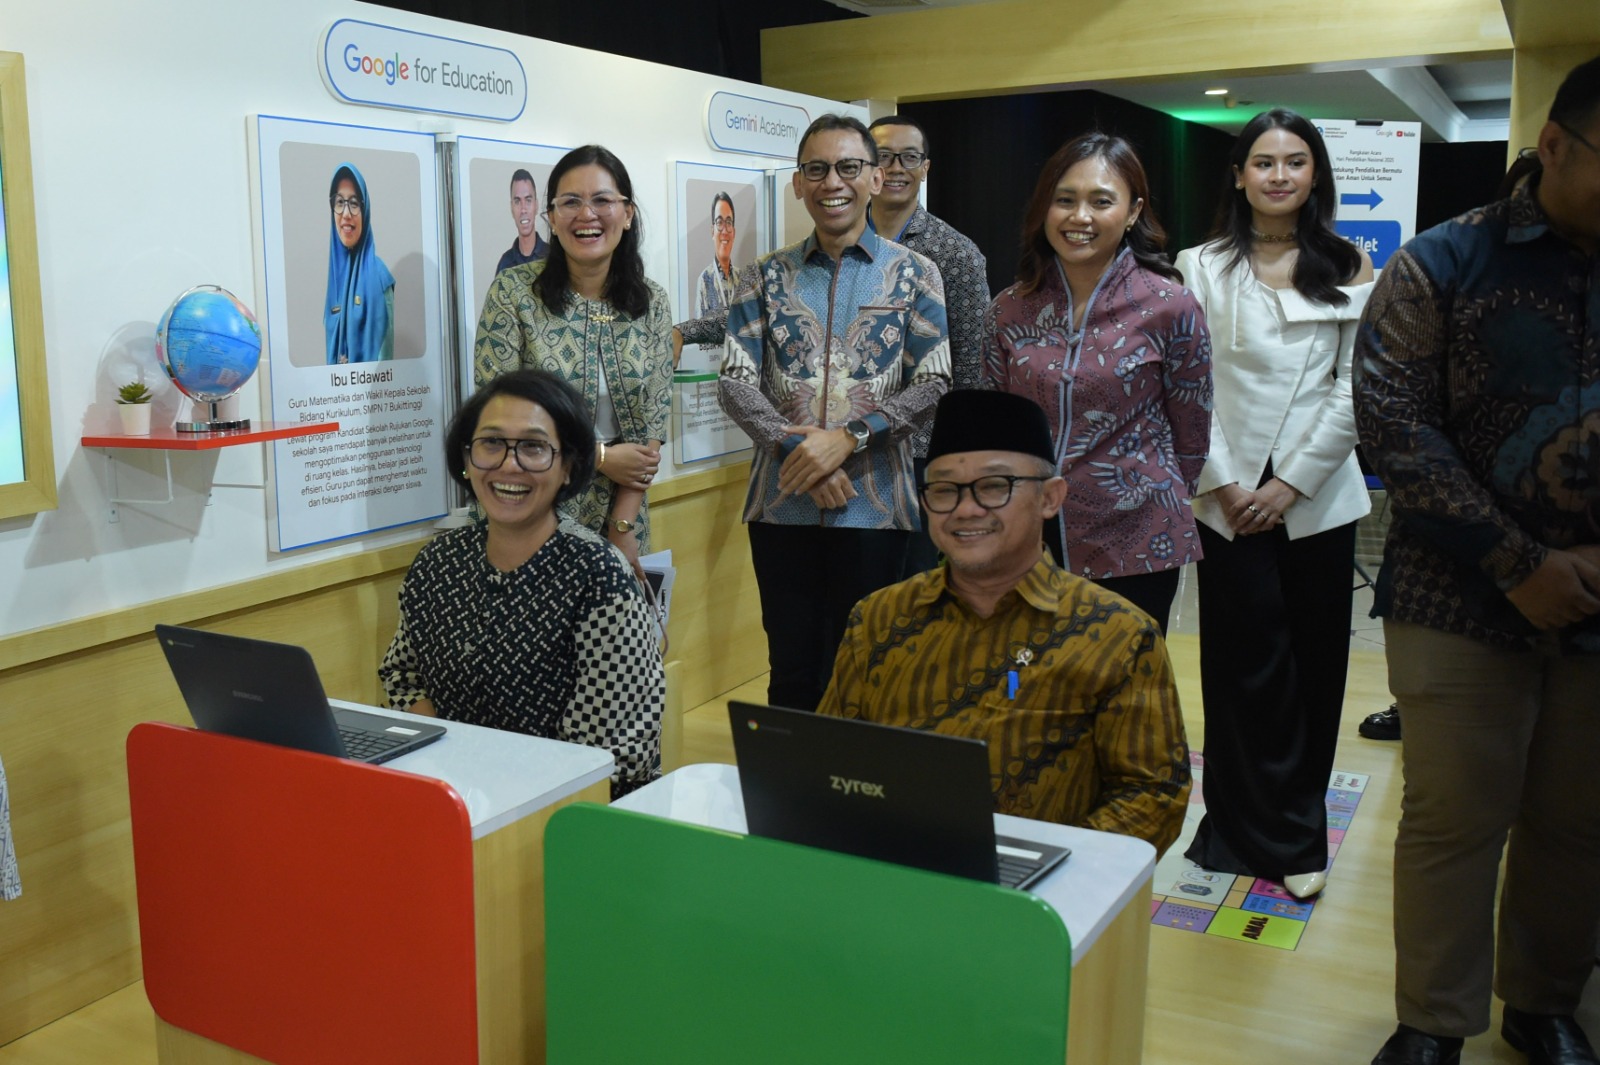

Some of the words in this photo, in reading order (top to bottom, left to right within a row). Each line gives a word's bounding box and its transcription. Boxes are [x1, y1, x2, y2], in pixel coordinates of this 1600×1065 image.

[344, 43, 409, 86] Google
[414, 58, 437, 84] for
[442, 62, 514, 96] Education
[726, 110, 758, 132] Gemini
[760, 116, 798, 144] Academy
[331, 372, 348, 387] Ibu
[350, 368, 393, 385] Eldawati
[288, 398, 308, 408] Guru
[309, 394, 350, 406] Matematika
[352, 392, 364, 402] dan
[366, 388, 383, 400] Wakil
[384, 388, 406, 400] Kepala
[406, 384, 430, 396] Sekolah
[300, 412, 324, 422] Bidang
[363, 402, 383, 414] SMPN
[384, 402, 388, 412] 7
[390, 399, 422, 412] Bukittinggi
[292, 446, 318, 458] sekolah
[318, 444, 334, 454] saya
[334, 440, 366, 450] mendapat
[366, 436, 388, 446] banyak
[389, 433, 415, 445] pelatihan
[416, 430, 431, 440] untuk
[308, 432, 336, 444] program
[338, 427, 364, 438] Kandidat
[366, 424, 388, 434] Sekolah
[390, 420, 412, 432] Rujukan
[305, 454, 357, 468] mengoptimalkan
[358, 448, 395, 462] penggunaan
[396, 442, 422, 454] teknologi
[305, 473, 312, 482] di
[312, 471, 332, 480] ruang
[378, 460, 398, 470] belajar
[398, 458, 408, 468] jadi
[410, 454, 424, 464] lebih
[326, 482, 342, 492] Guru
[343, 480, 355, 490] pun
[356, 476, 374, 486] dapat
[410, 467, 428, 476] waktu
[308, 499, 320, 508] dan
[322, 496, 340, 505] fokus
[340, 492, 356, 503] pada
[356, 487, 382, 499] interaksi
[383, 482, 404, 494] dengan
[830, 774, 885, 798] zyrex
[1241, 916, 1269, 940] AMAL
